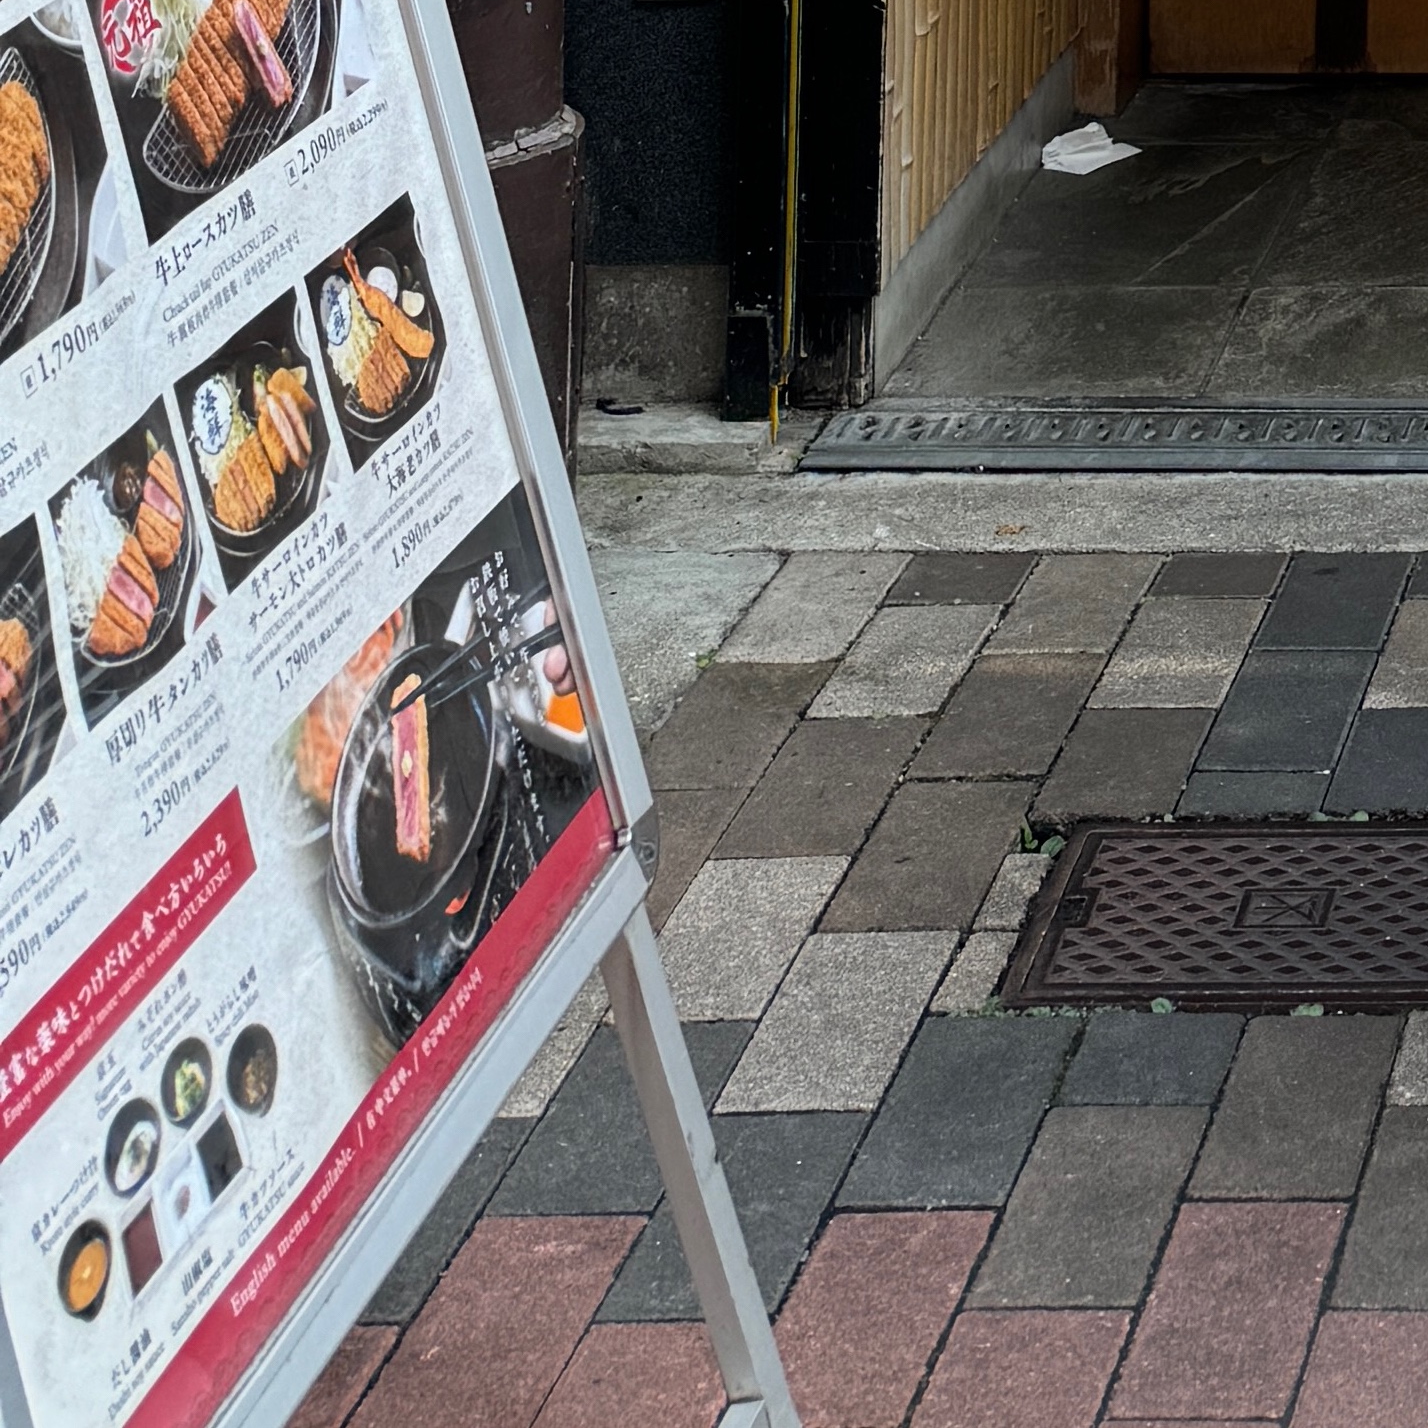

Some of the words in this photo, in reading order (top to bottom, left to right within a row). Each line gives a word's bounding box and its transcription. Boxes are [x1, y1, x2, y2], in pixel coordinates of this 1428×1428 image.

[297, 125, 347, 176] 2,090円
[154, 188, 257, 288] 牛上ロースカツ膳
[37, 320, 100, 384] 1,790円
[104, 631, 225, 768] 厚切り牛タンカツ膳
[140, 775, 192, 839] 2,390円
[228, 1252, 278, 1318] English
[277, 1209, 311, 1260] menu
[308, 1146, 357, 1216] available.
